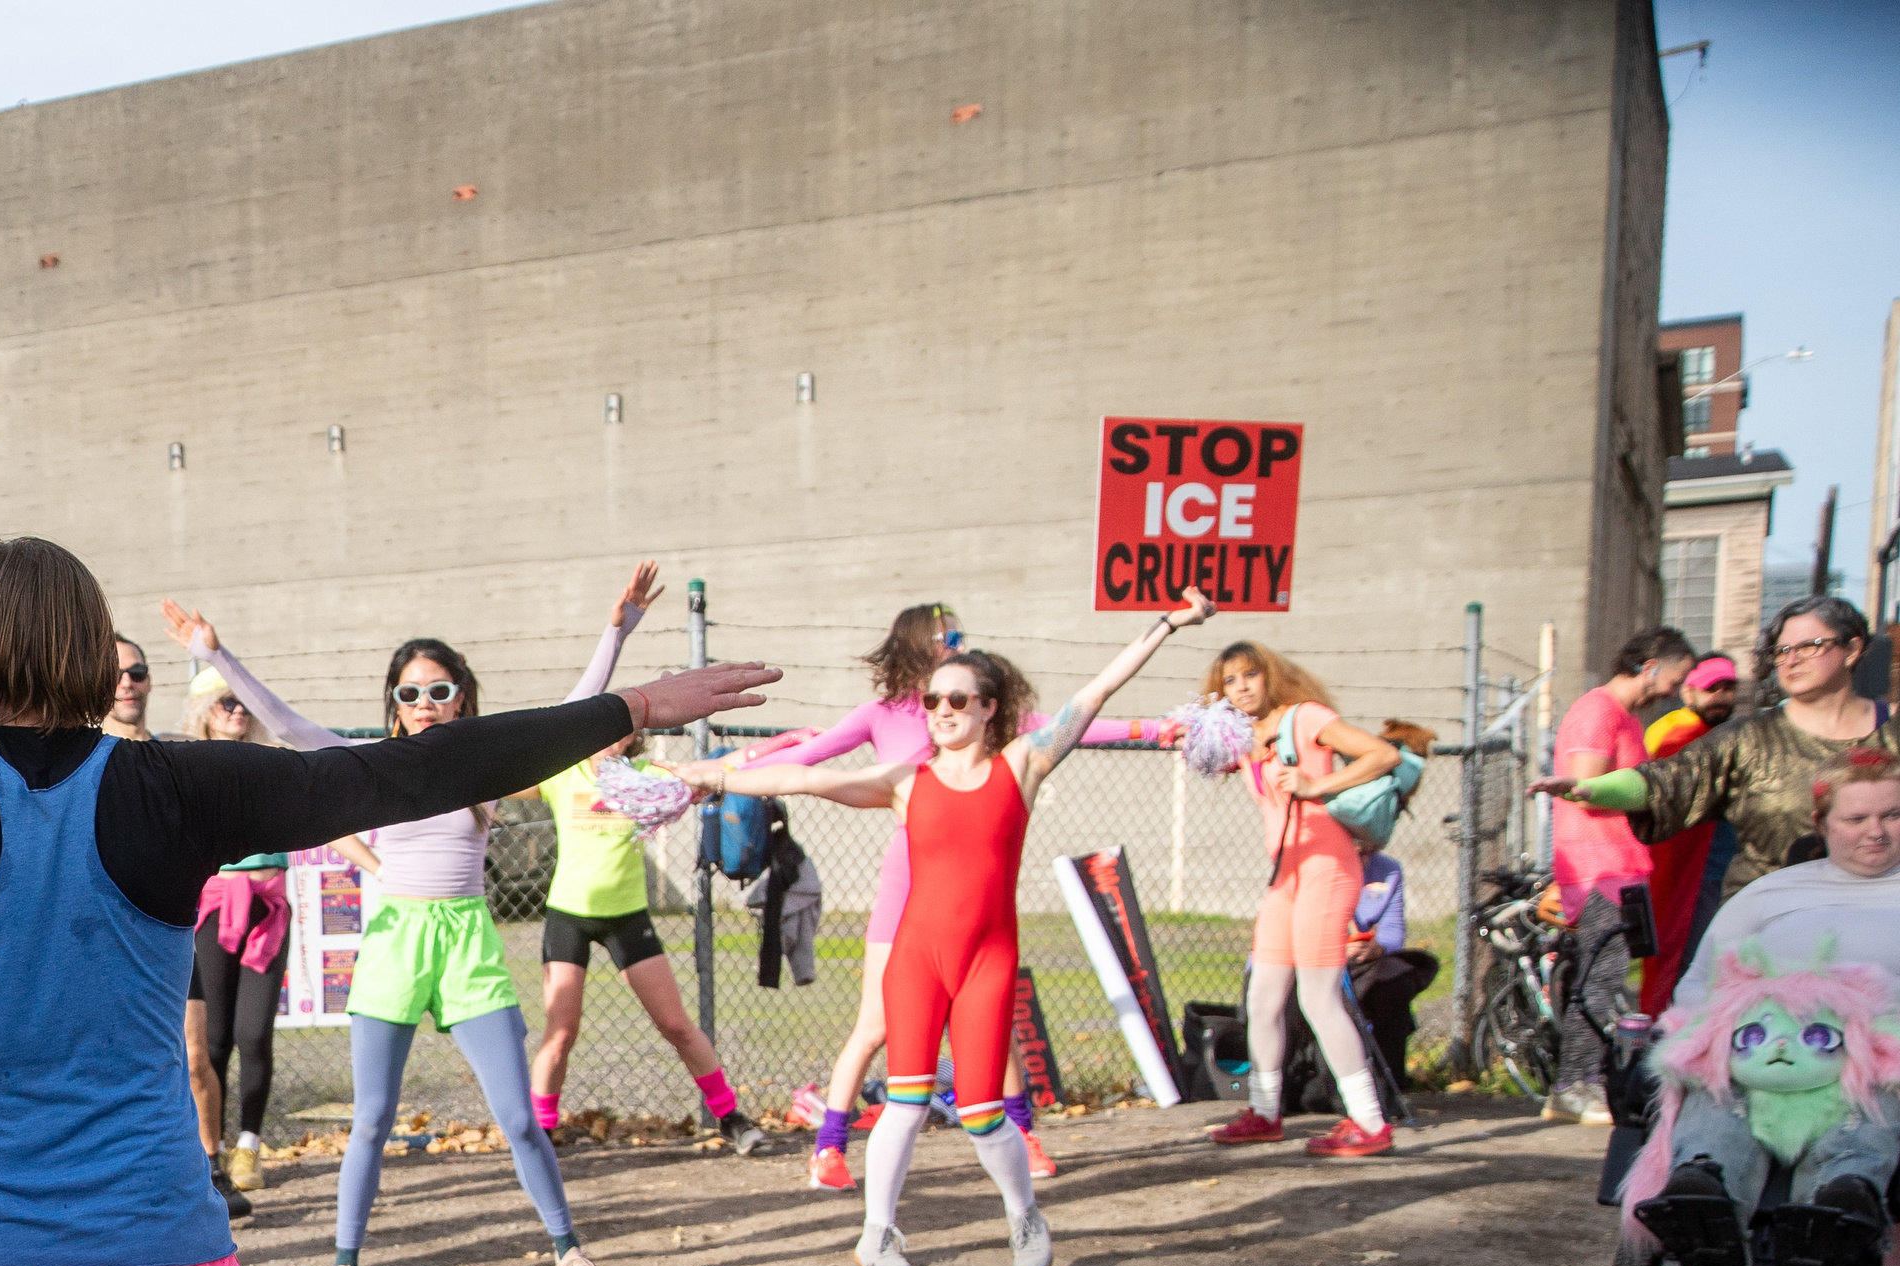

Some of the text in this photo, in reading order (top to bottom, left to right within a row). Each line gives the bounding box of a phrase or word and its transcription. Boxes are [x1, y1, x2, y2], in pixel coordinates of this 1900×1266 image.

[1108, 423, 1298, 478] STOP
[1144, 481, 1257, 538] ICE
[1103, 541, 1291, 604] CRUELTY
[1013, 977, 1057, 1107] Doctors
